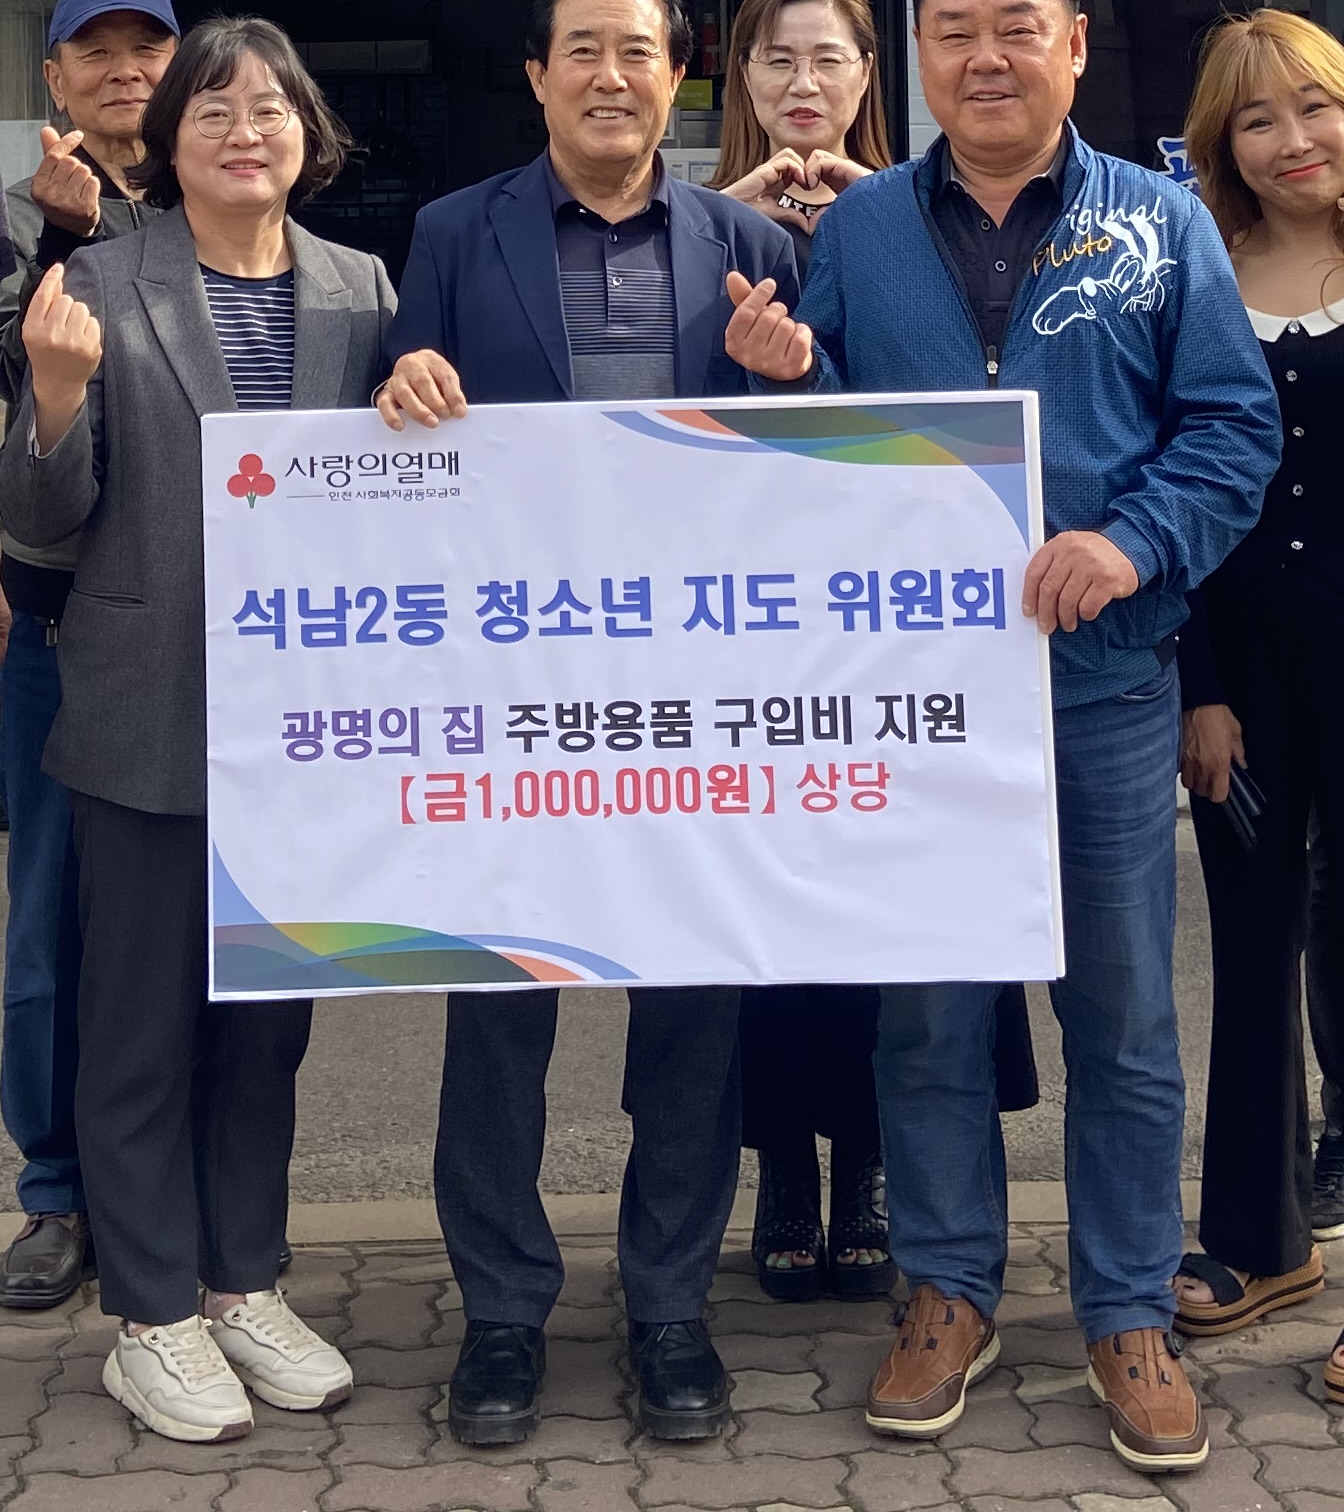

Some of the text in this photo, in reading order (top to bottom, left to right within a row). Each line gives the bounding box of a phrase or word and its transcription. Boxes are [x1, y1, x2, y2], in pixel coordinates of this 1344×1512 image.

[1031, 231, 1114, 277] Pluto
[284, 450, 460, 488] 사랑의열매
[231, 567, 1007, 650] 석남2동 청소년 지도 위원회
[281, 692, 967, 762] 광명의 집 주방용품 구입비 지원
[795, 761, 891, 813] 상당
